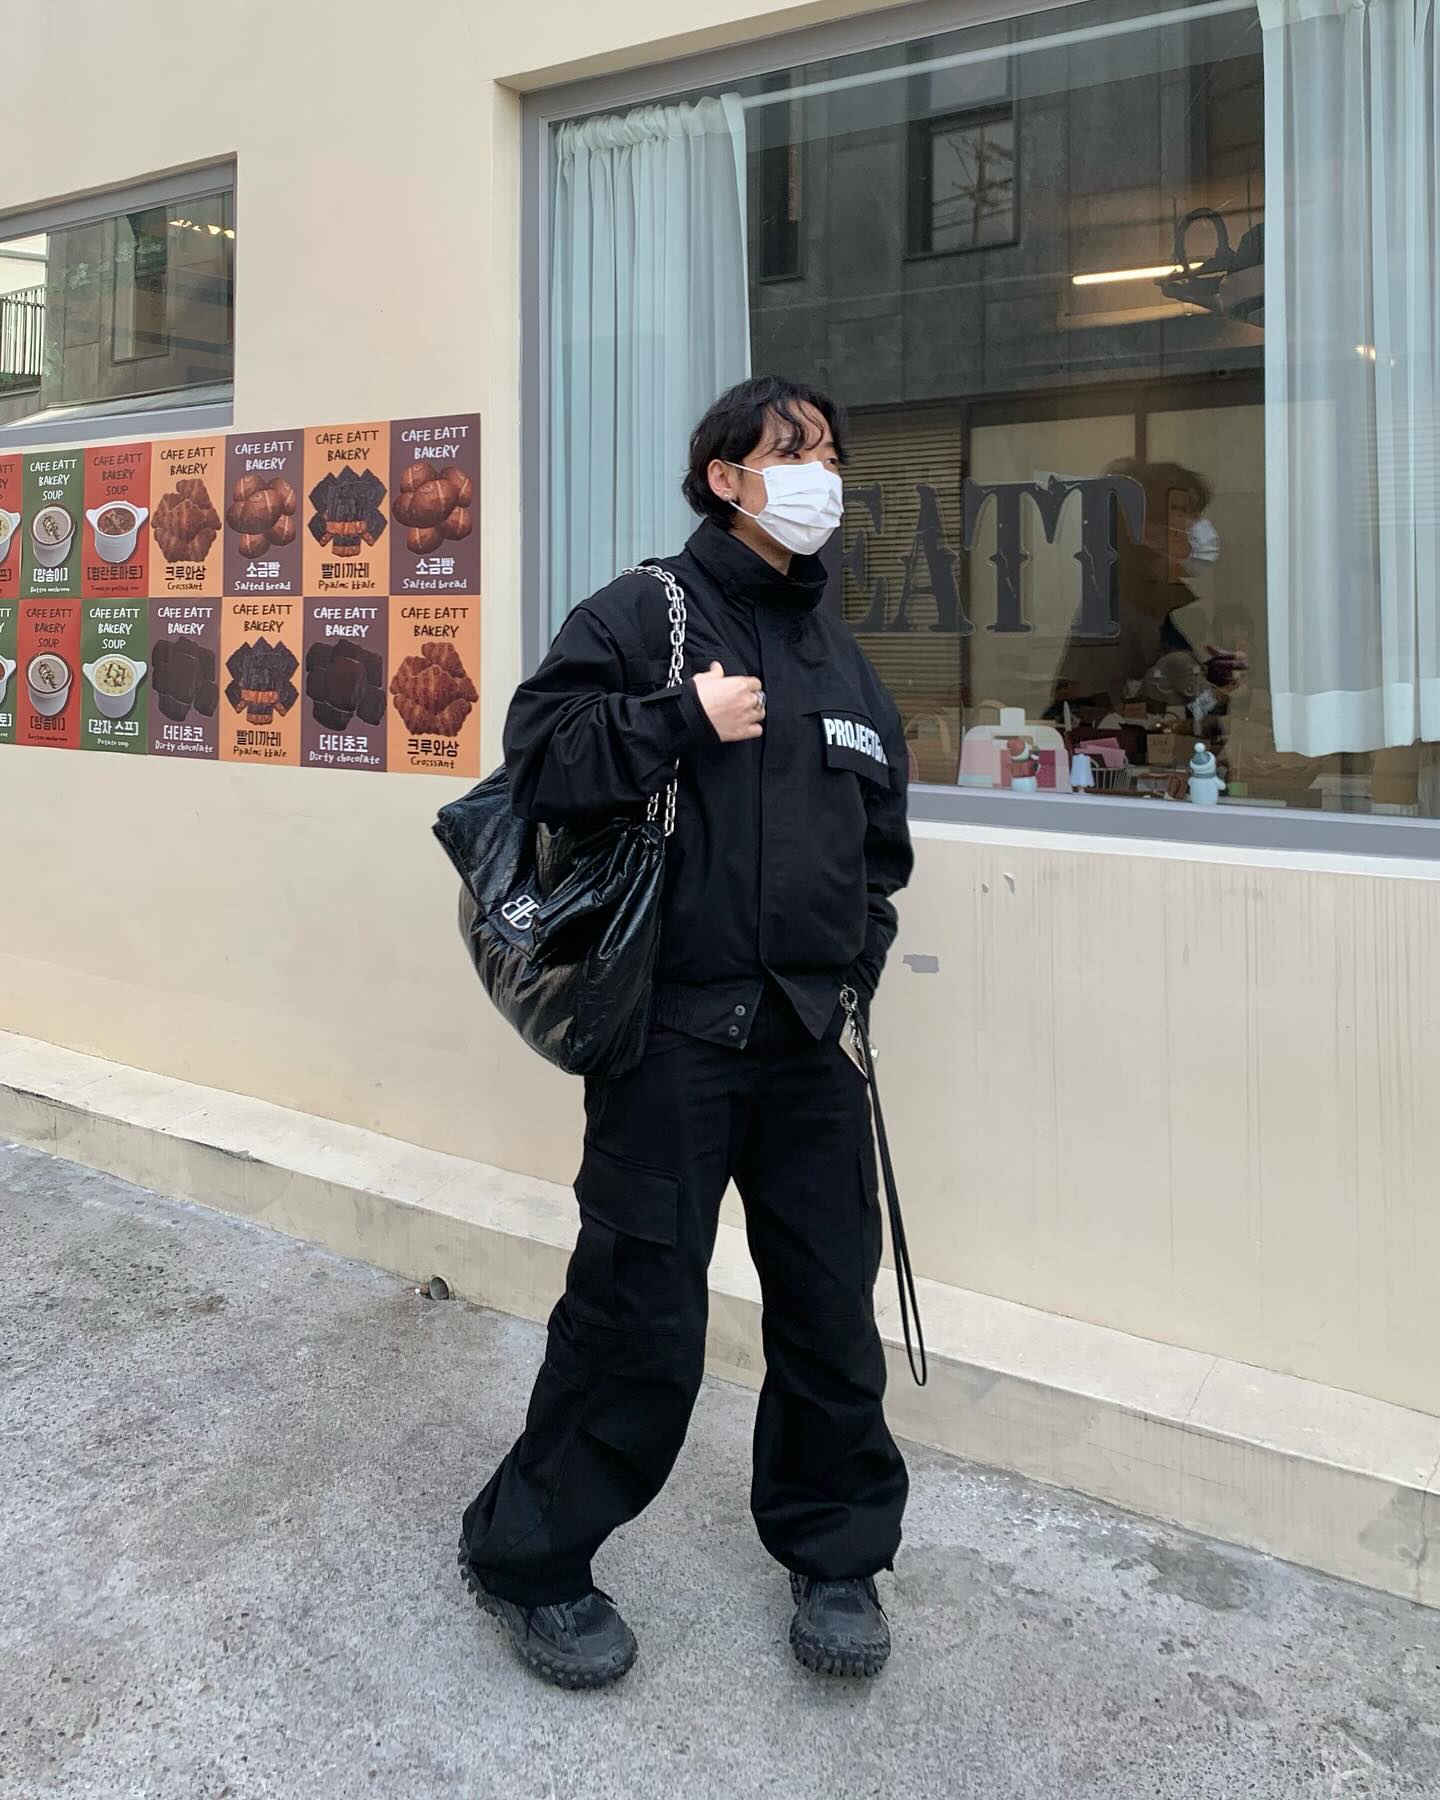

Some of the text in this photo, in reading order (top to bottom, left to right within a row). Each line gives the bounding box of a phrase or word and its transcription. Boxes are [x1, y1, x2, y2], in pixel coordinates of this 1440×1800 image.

[316, 430, 379, 444] CAFE EATT
[402, 426, 469, 442] CAFE EATT
[161, 447, 216, 460] CAFE EATT
[235, 441, 294, 455] CAFE EATT
[328, 448, 370, 461] BAKERY
[414, 444, 459, 460] BAKERY
[30, 459, 77, 472] CAFE EATT
[94, 453, 143, 466] CAFE EATT
[246, 458, 285, 471] BAKERY
[102, 469, 135, 481] BAKERY
[170, 463, 208, 475] BAKERY
[39, 474, 70, 487] BAKERY
[42, 490, 63, 500] SOUP
[106, 486, 128, 496] SOUP
[165, 565, 206, 581] 크루와상
[246, 562, 280, 577] 소금빵
[416, 558, 455, 575] 소금빵
[234, 581, 291, 591] Salted bread
[403, 579, 467, 589] Salted bread
[27, 608, 73, 618] CAFE EATT
[89, 608, 141, 619] CAFE EATT
[157, 607, 213, 618] CAFE EATT
[233, 604, 292, 615] CAFE EATT
[314, 606, 378, 619] CAFE EATT
[402, 606, 469, 619] CAFE EATT
[35, 623, 66, 633] BAKERY
[98, 623, 133, 635] BAKERY
[168, 623, 205, 635] BAKERY
[244, 621, 284, 633] BAKERY
[326, 624, 369, 638] BAKERY
[414, 625, 459, 638] BAKERY
[38, 638, 59, 648] SOUP
[102, 639, 126, 649] SOUP
[155, 740, 214, 753] Dirty chocolate
[408, 738, 459, 757] 크루와상
[309, 751, 380, 765] Dirty chocolate
